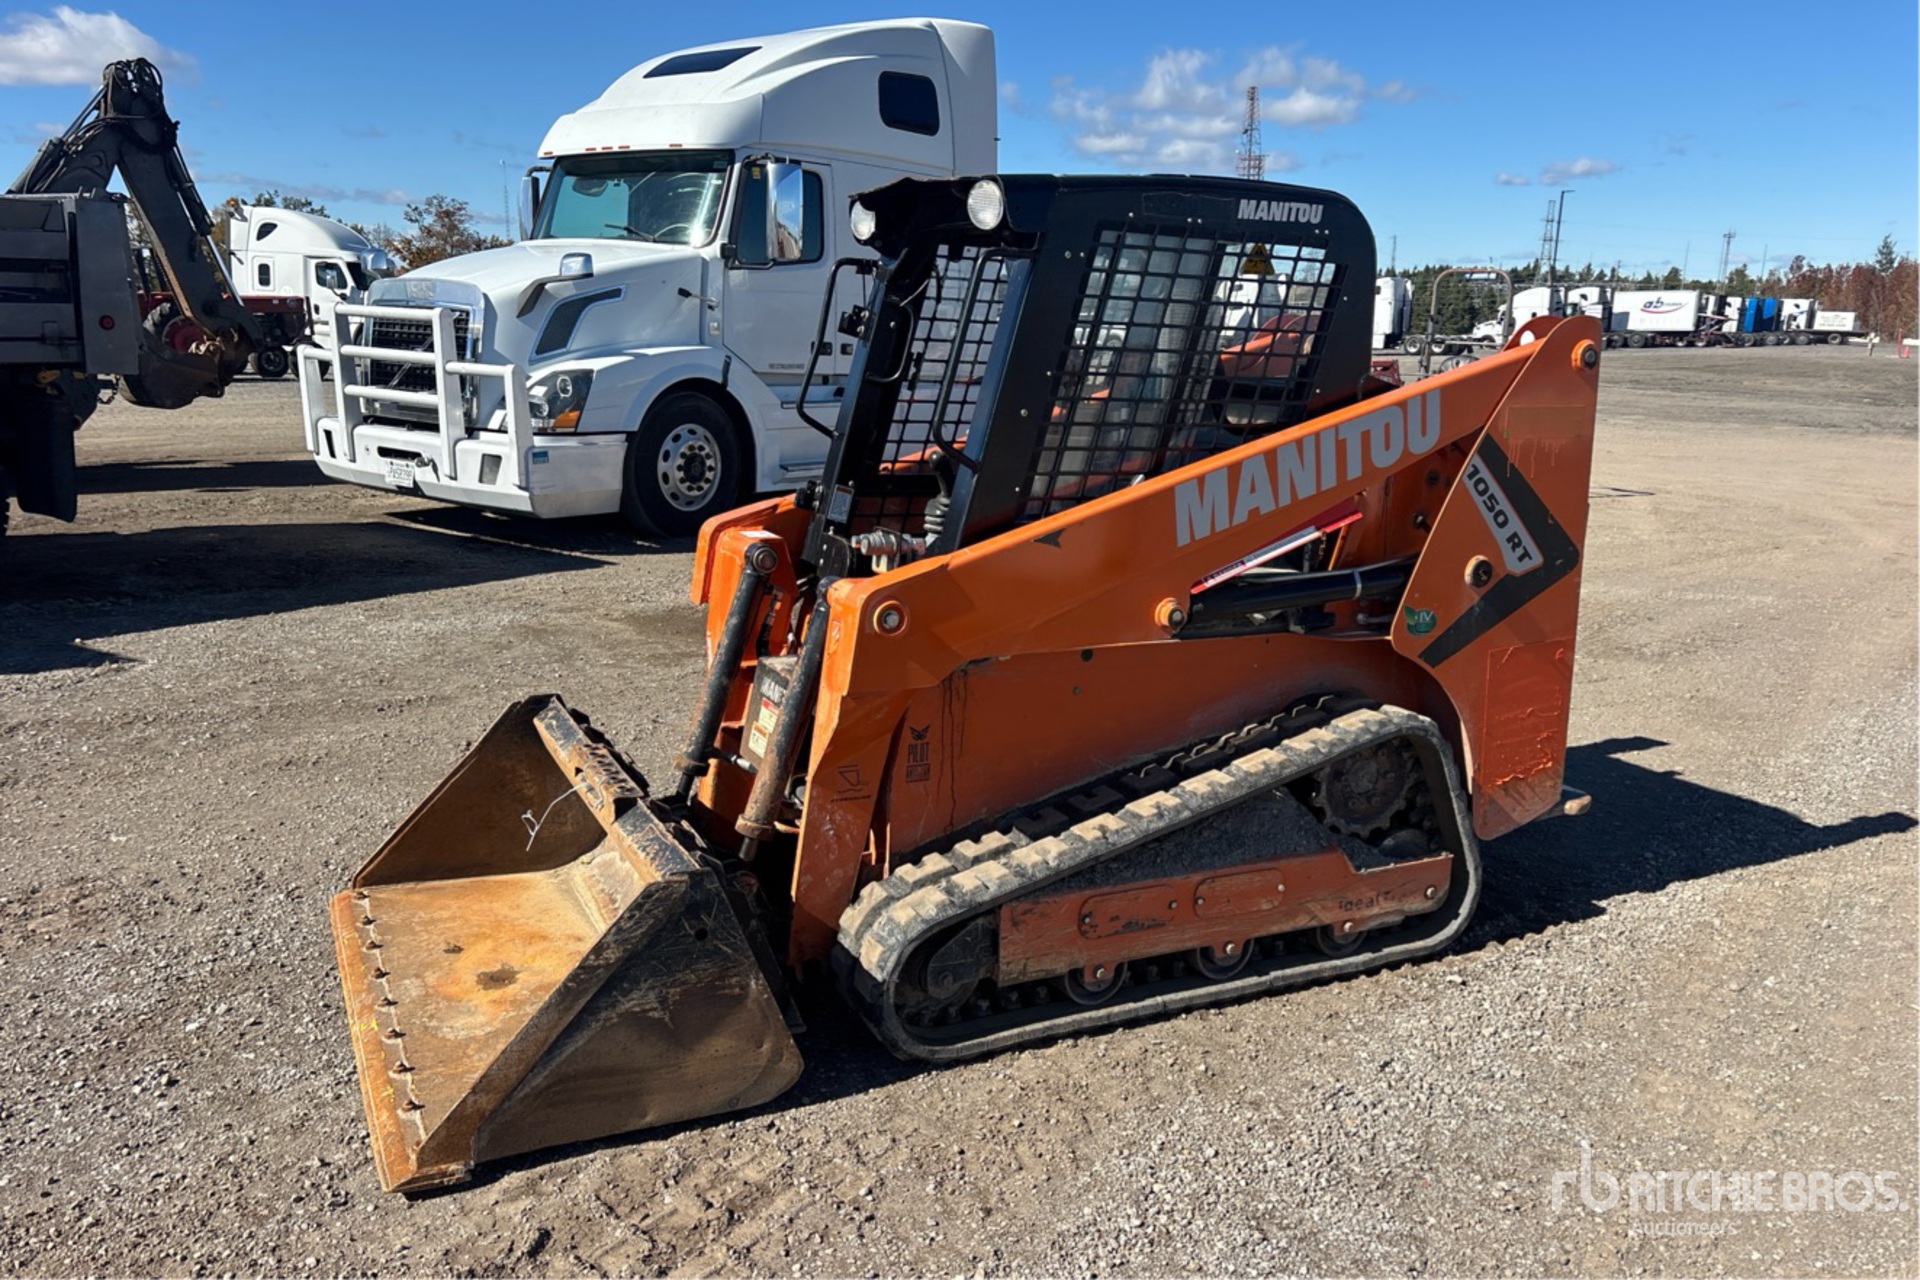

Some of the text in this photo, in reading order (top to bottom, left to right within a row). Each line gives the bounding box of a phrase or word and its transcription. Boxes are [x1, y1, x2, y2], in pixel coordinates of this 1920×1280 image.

[1237, 199, 1323, 224] MANITOU
[1174, 388, 1440, 548] MANITOU
[1466, 464, 1533, 563] 1050 RT
[908, 742, 930, 764] PILOT
